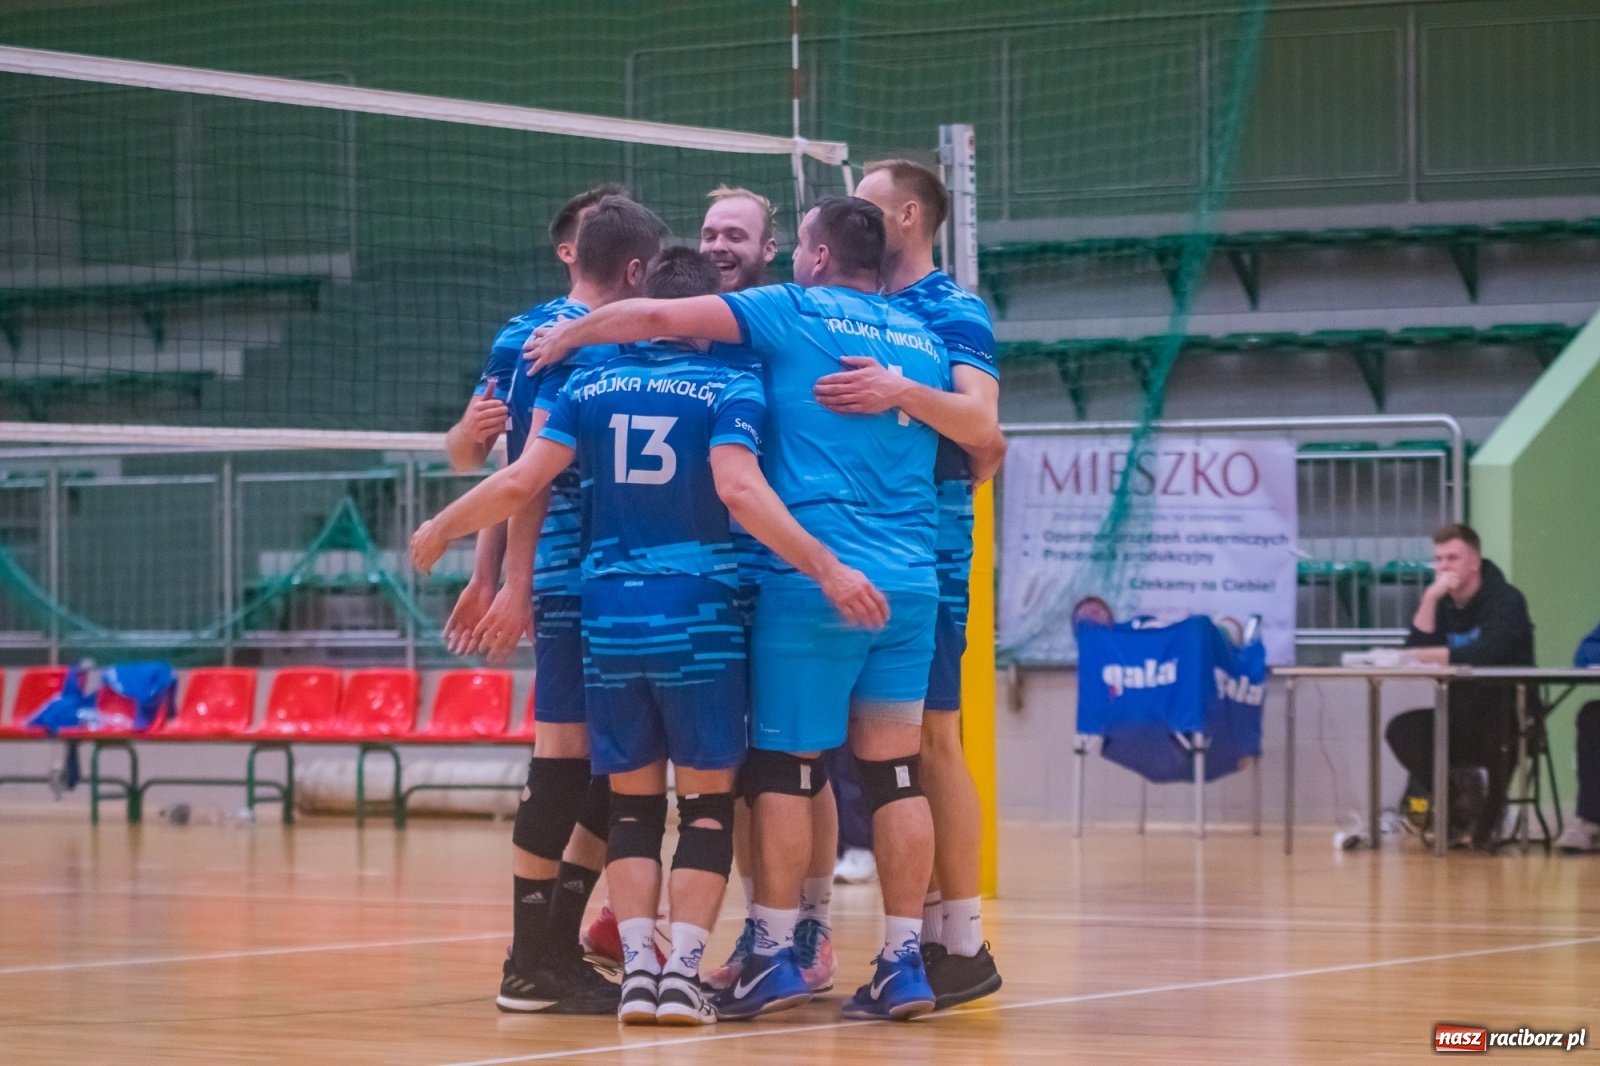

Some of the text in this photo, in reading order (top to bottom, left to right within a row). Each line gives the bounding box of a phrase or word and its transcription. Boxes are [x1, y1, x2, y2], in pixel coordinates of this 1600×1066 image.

[573, 374, 716, 407] TRÓJKA MIKOŁÓW
[608, 413, 677, 485] 13
[1039, 451, 1260, 498] MIESZKO
